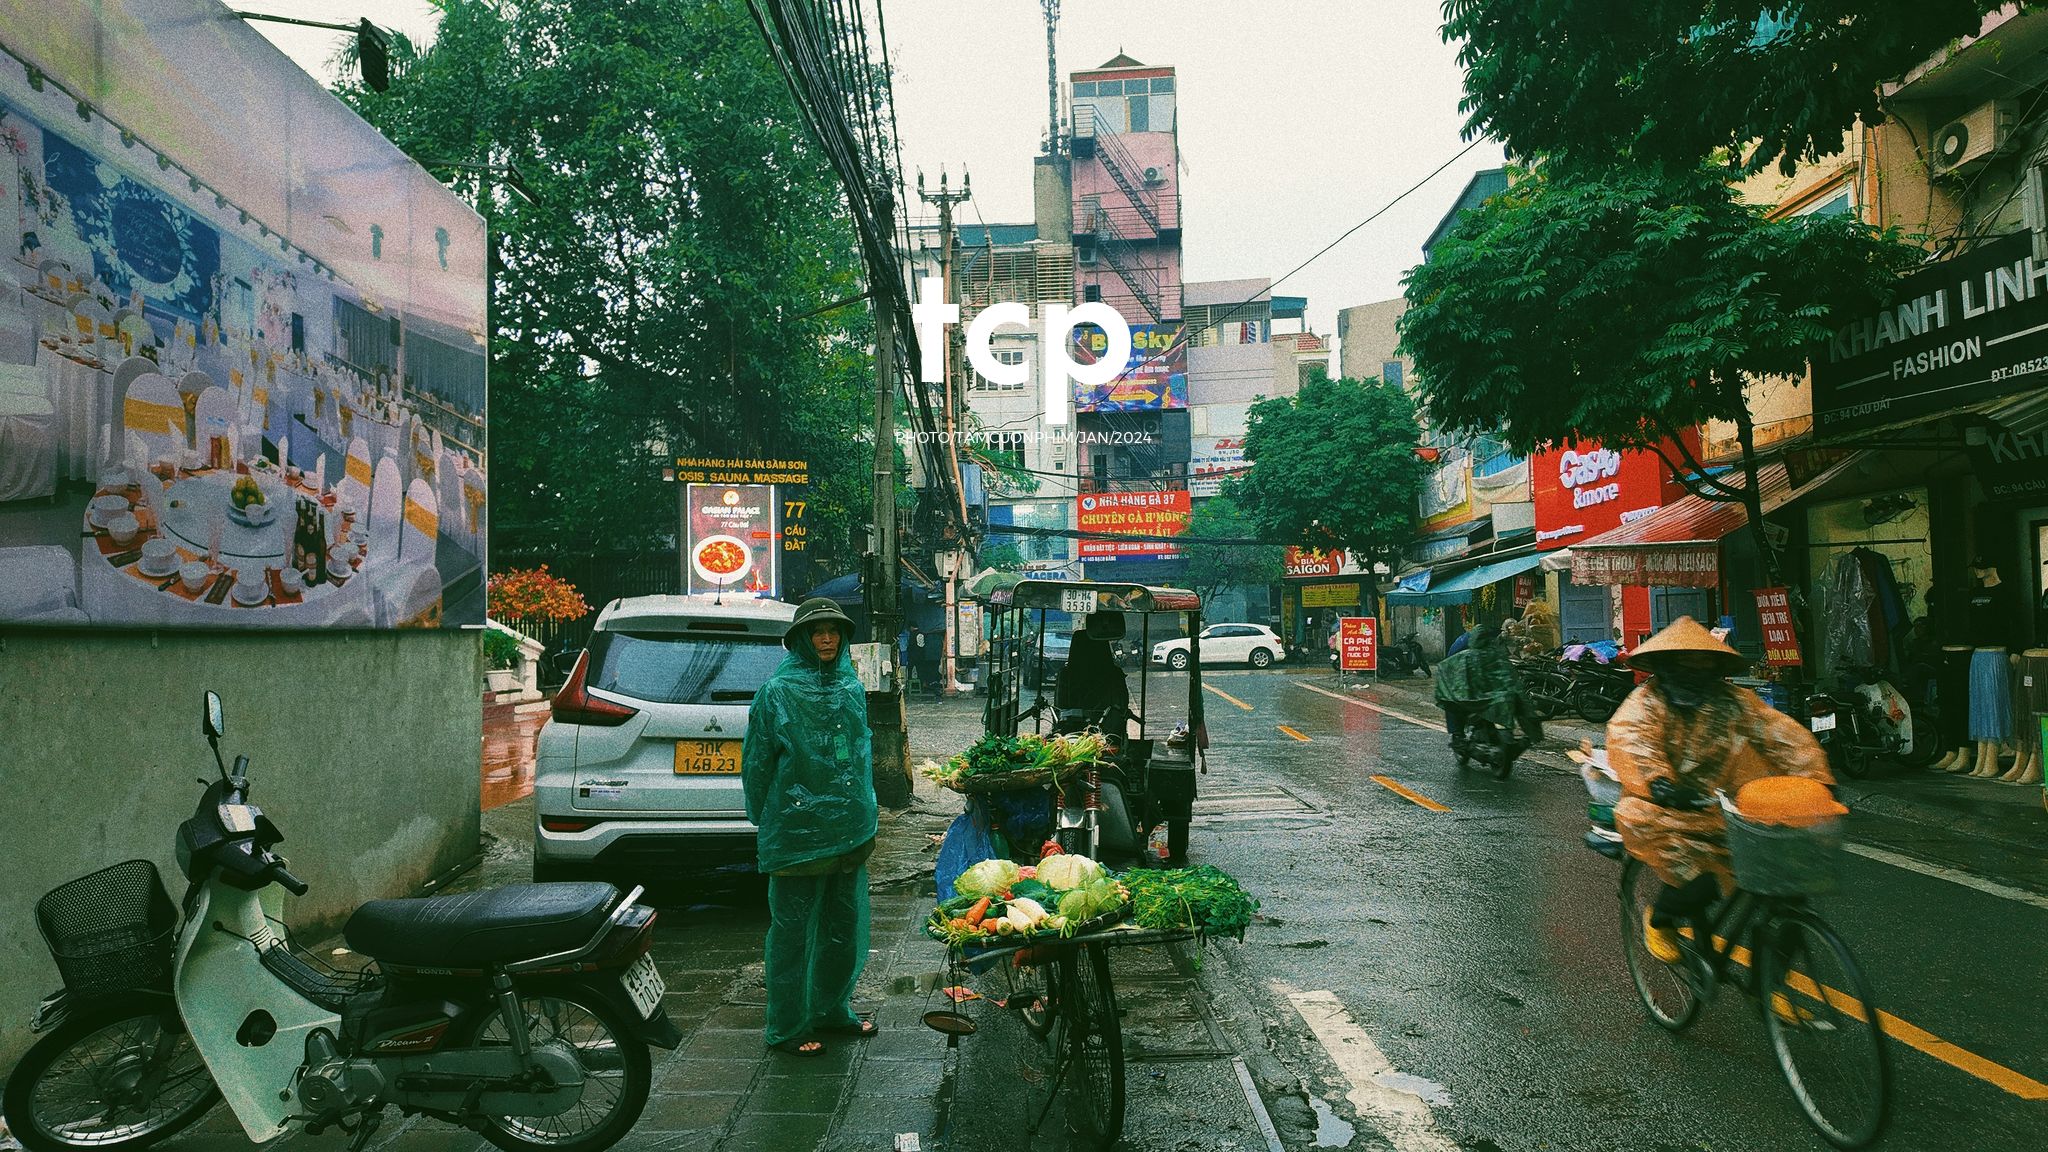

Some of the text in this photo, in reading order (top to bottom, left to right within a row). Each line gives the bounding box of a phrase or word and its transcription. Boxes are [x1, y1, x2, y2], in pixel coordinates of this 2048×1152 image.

[1961, 256, 2048, 320] LINH
[1133, 331, 1175, 352] Sky
[1893, 336, 1981, 381] FASHION
[678, 471, 809, 484] OSIS SAUNA MASSAGE
[784, 501, 807, 519] 77
[1081, 511, 1126, 525] CHUYÊN
[1128, 510, 1144, 523] GÀ
[1286, 563, 1330, 575] SAIGON
[1066, 590, 1091, 600] 30-H4
[1066, 601, 1091, 611] 3536
[695, 742, 724, 756] 30K
[684, 758, 735, 771] 148.23
[416, 968, 453, 976] HONDA
[377, 1039, 421, 1048] Dream
